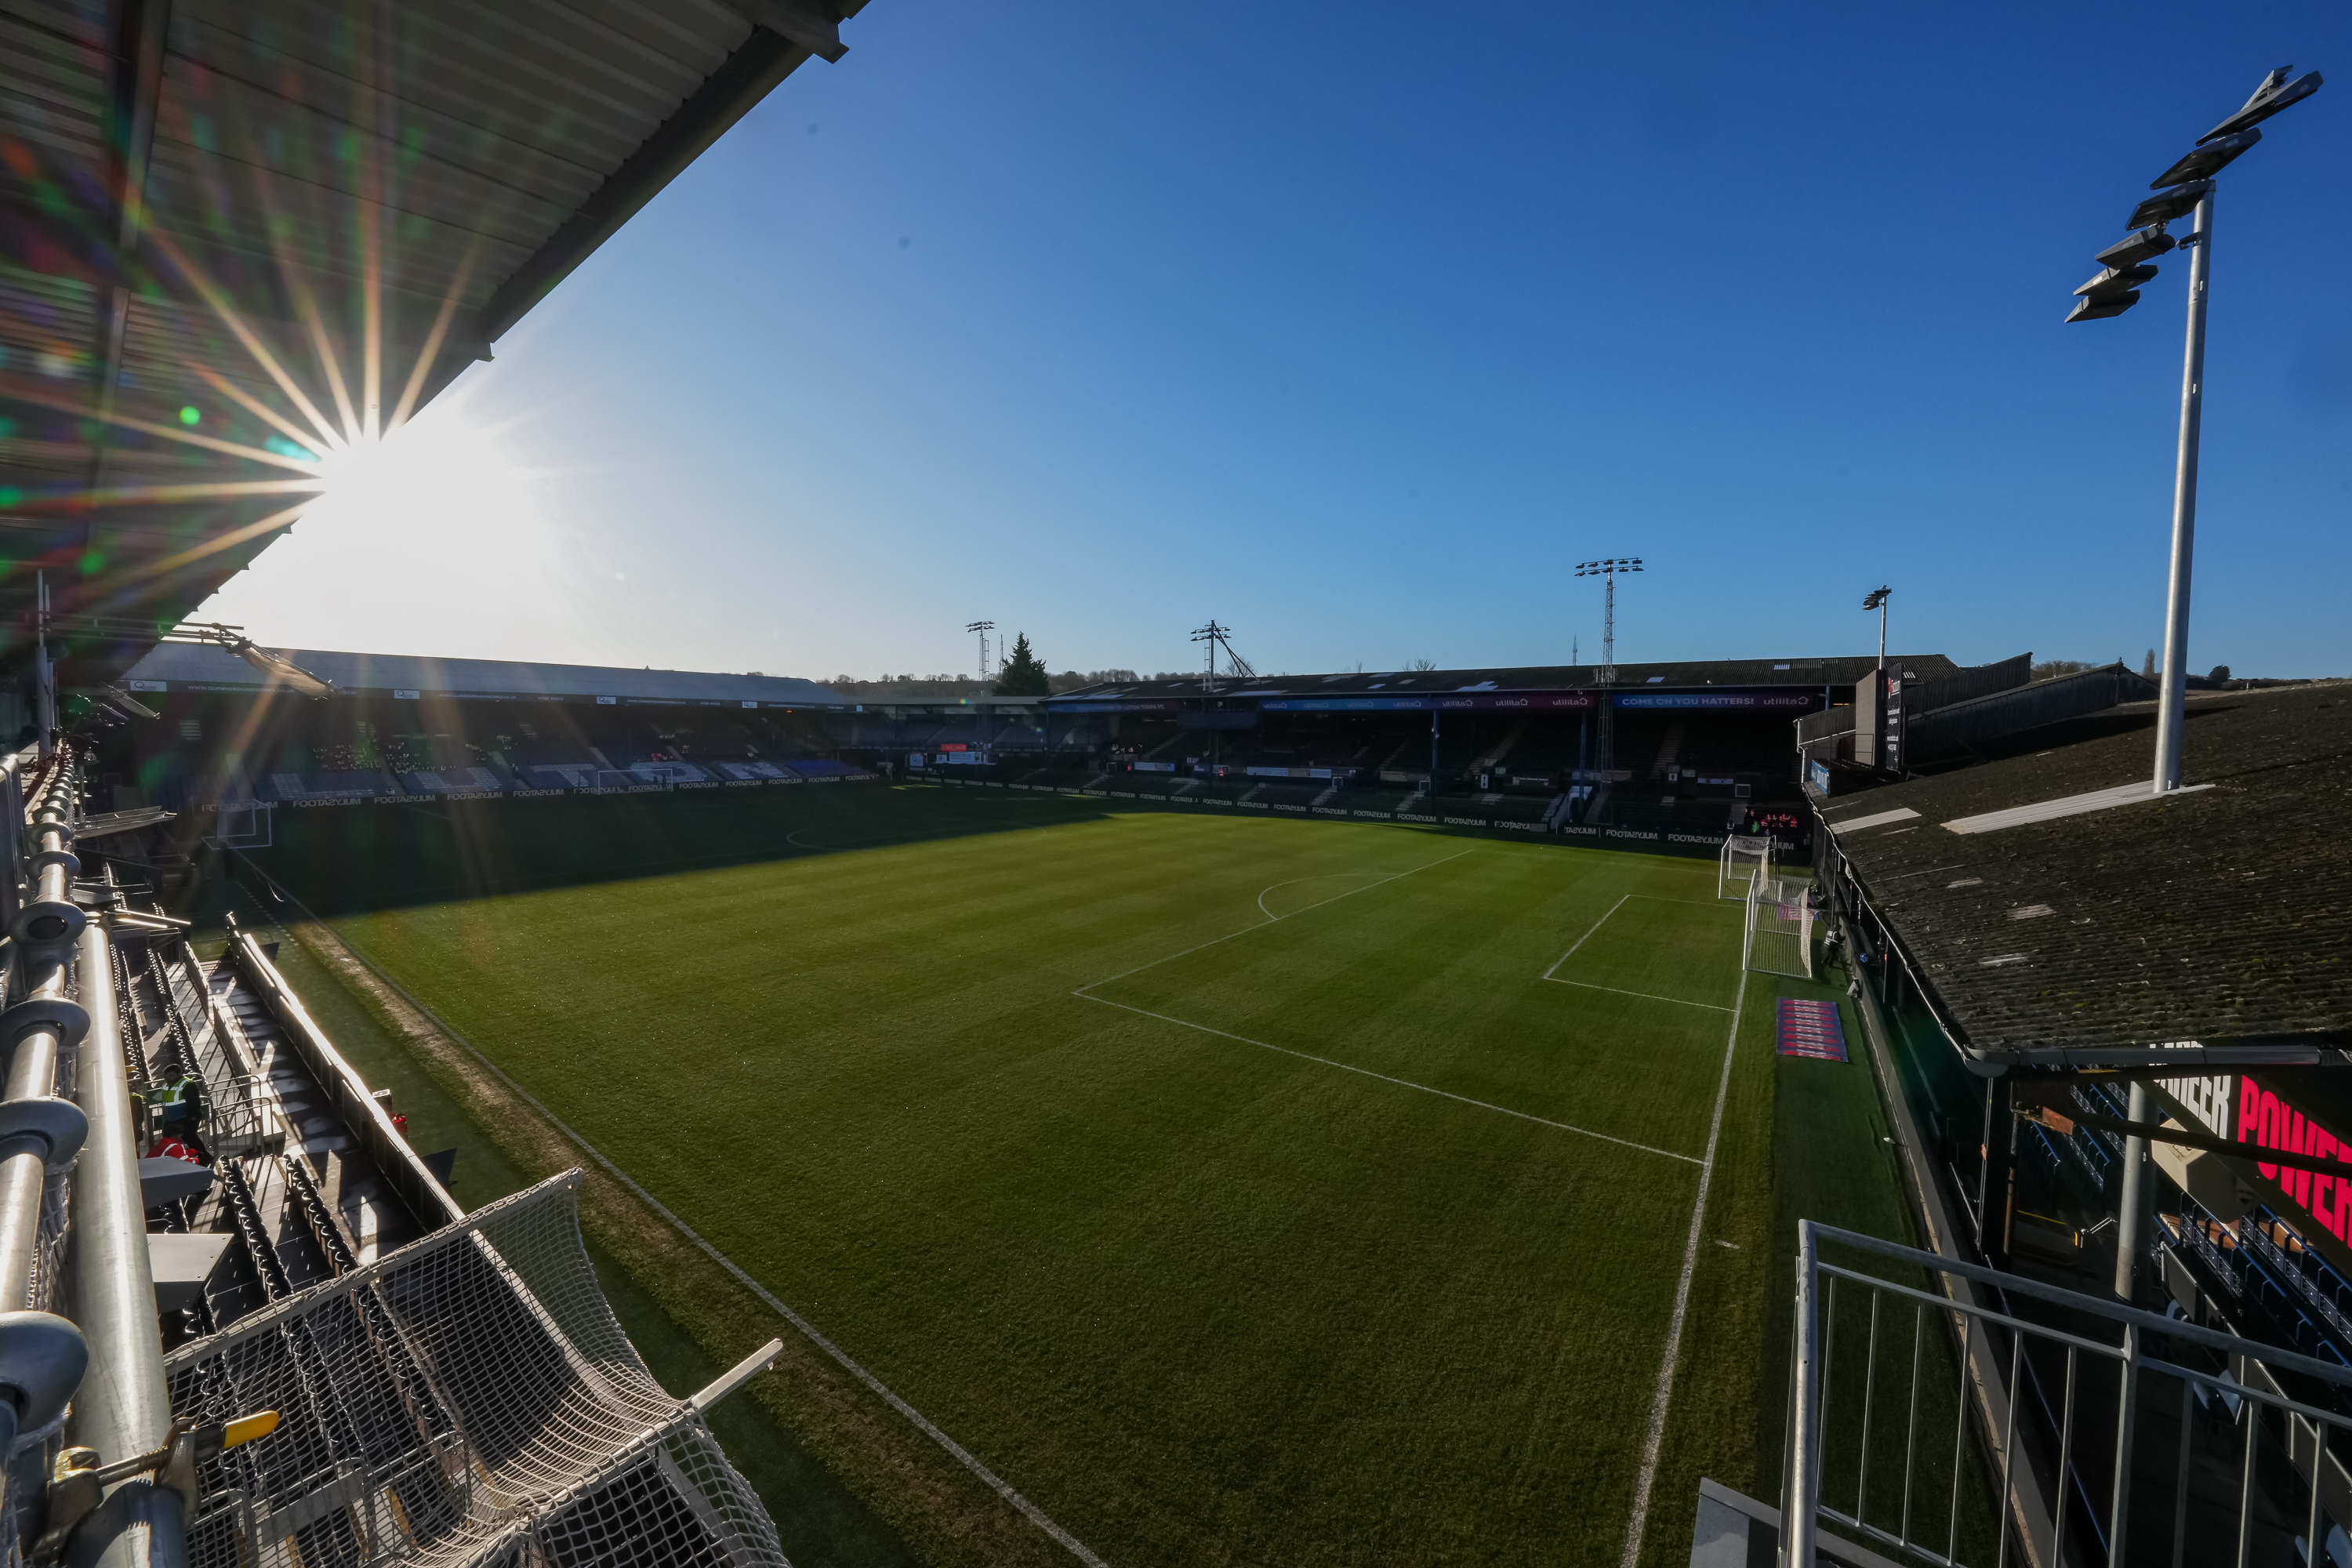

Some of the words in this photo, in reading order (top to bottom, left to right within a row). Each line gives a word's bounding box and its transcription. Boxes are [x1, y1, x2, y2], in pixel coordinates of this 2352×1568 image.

[374, 795, 435, 804] FOOTASYLUM
[447, 792, 503, 800] FOOTASYLUM
[293, 797, 361, 808] FOOTASYLUM
[1353, 810, 1390, 818] FOOTASYLUM
[1444, 817, 1486, 826] FOOTASYLUM
[1606, 829, 1657, 839] FOOTASYLUM
[1668, 833, 1723, 844] FOOTASYLUM
[2238, 1075, 2352, 1250] POWER
